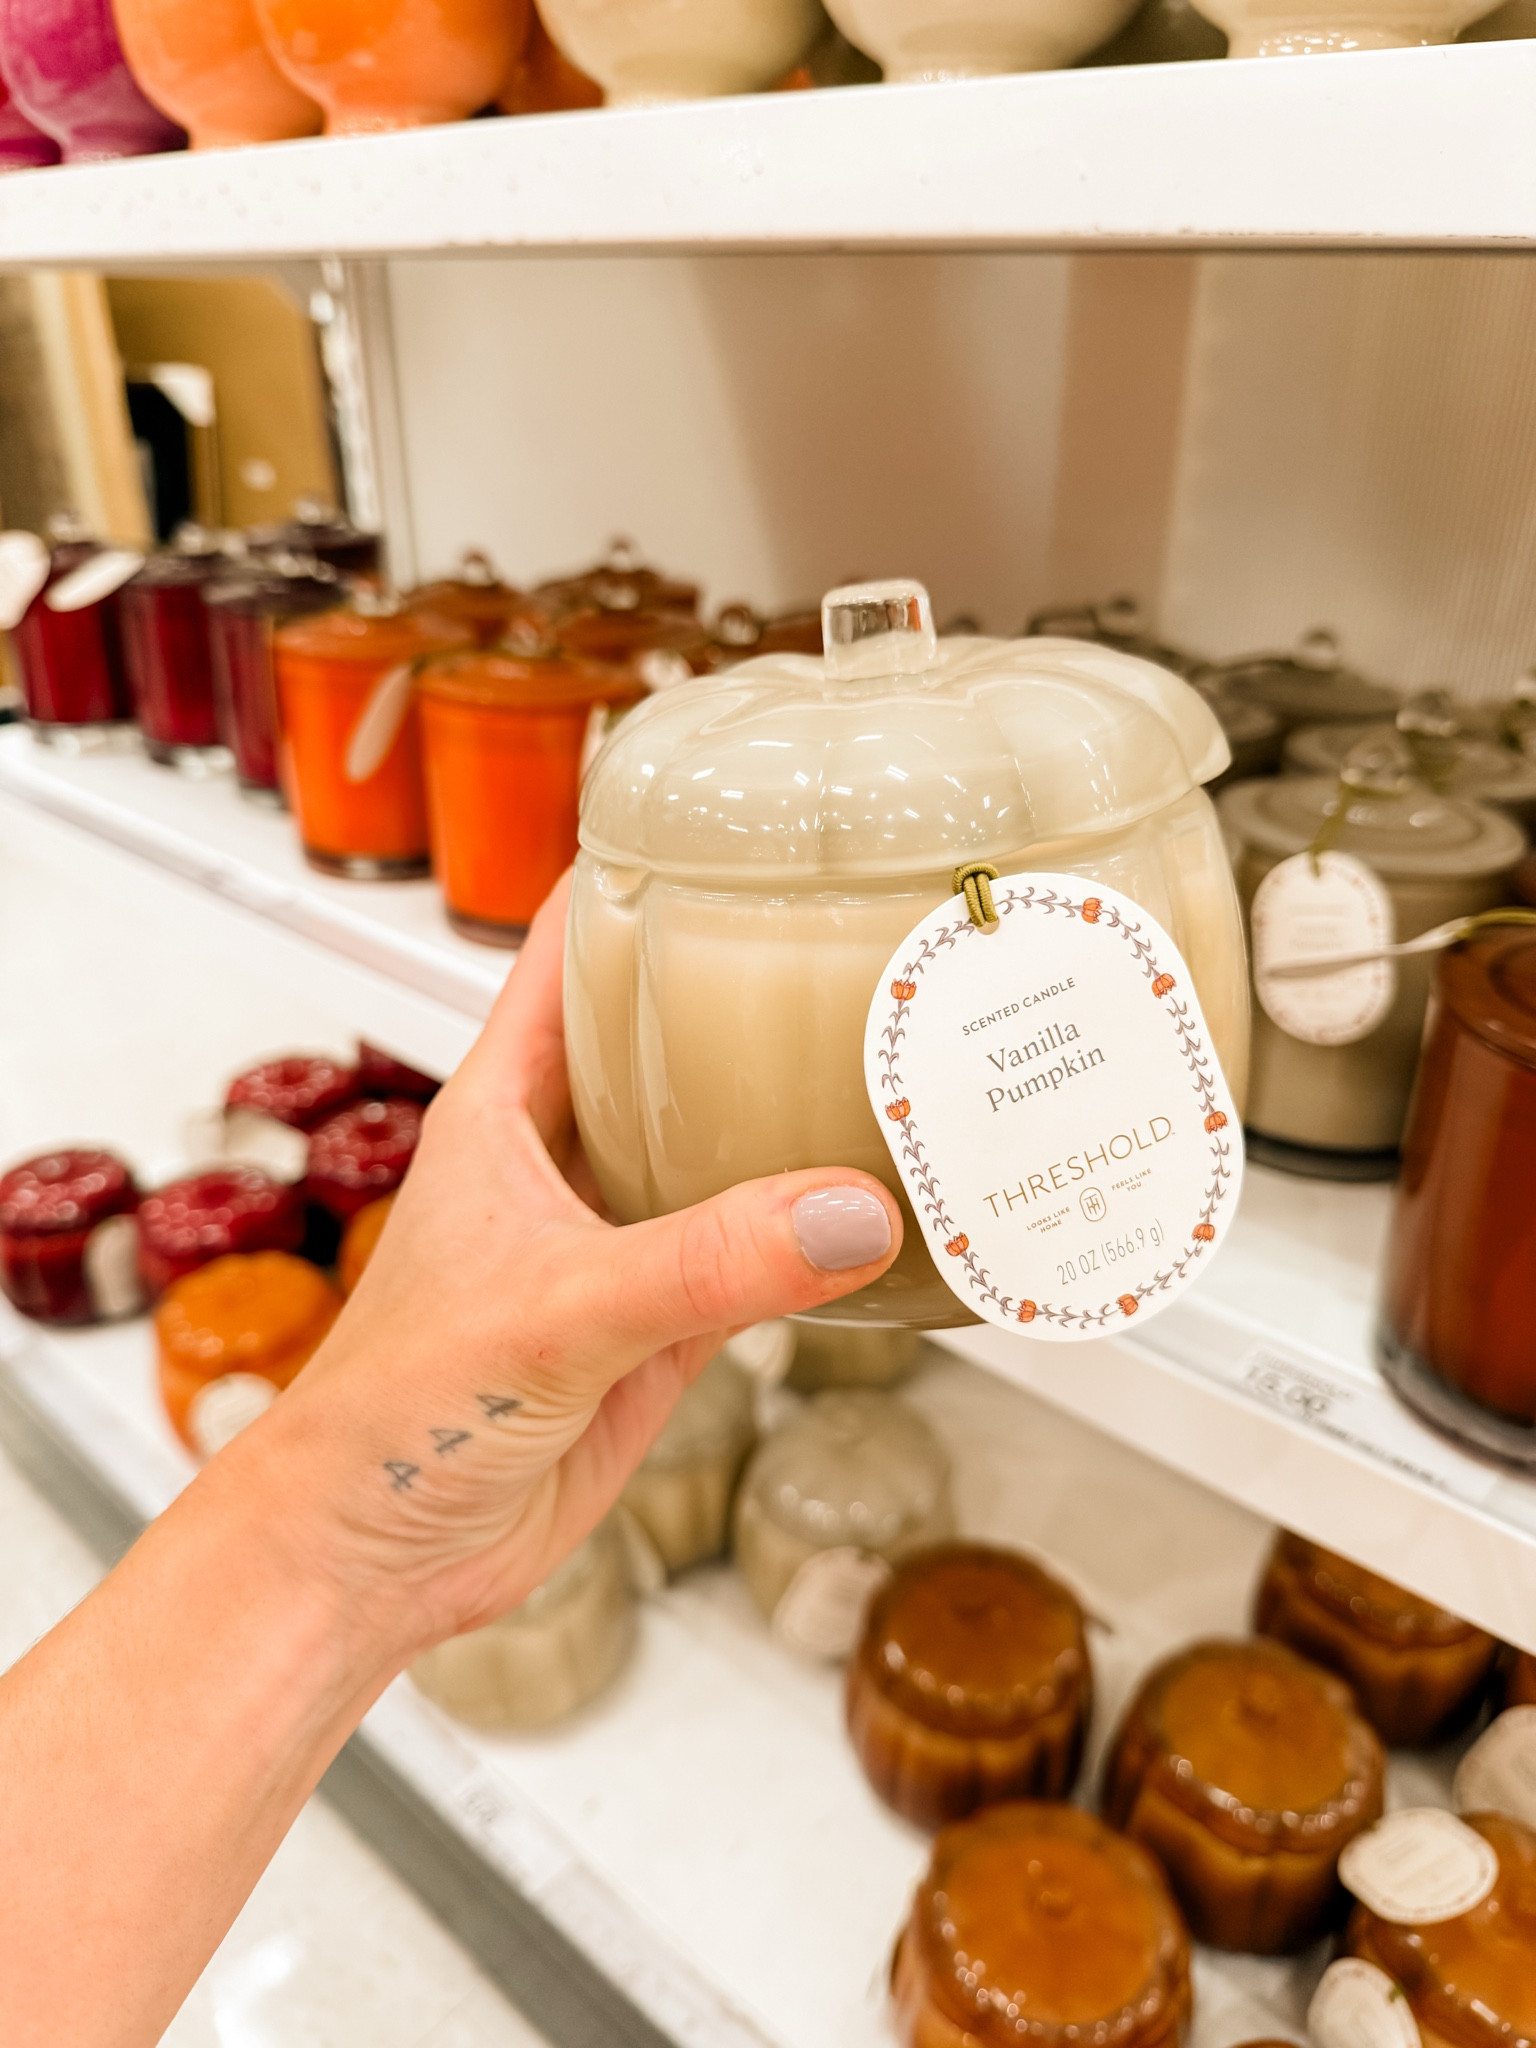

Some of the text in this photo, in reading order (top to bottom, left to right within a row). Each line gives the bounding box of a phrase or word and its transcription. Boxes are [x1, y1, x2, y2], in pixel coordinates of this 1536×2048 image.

[962, 977, 1076, 1036] SCENTED CANDLE
[986, 1023, 1081, 1073] Vanilla
[986, 1048, 1106, 1113] Pumpkin
[982, 1117, 1172, 1218] THRESHOLD
[1112, 1168, 1152, 1191] FEELS LIKE
[1127, 1181, 1142, 1192] YOU
[1026, 1206, 1071, 1231] LOOKS LIKE
[1040, 1219, 1062, 1233] HOME
[1056, 1218, 1165, 1286] 20 OZ (566.9 g)
[383, 1394, 523, 1491] 4 4 4
